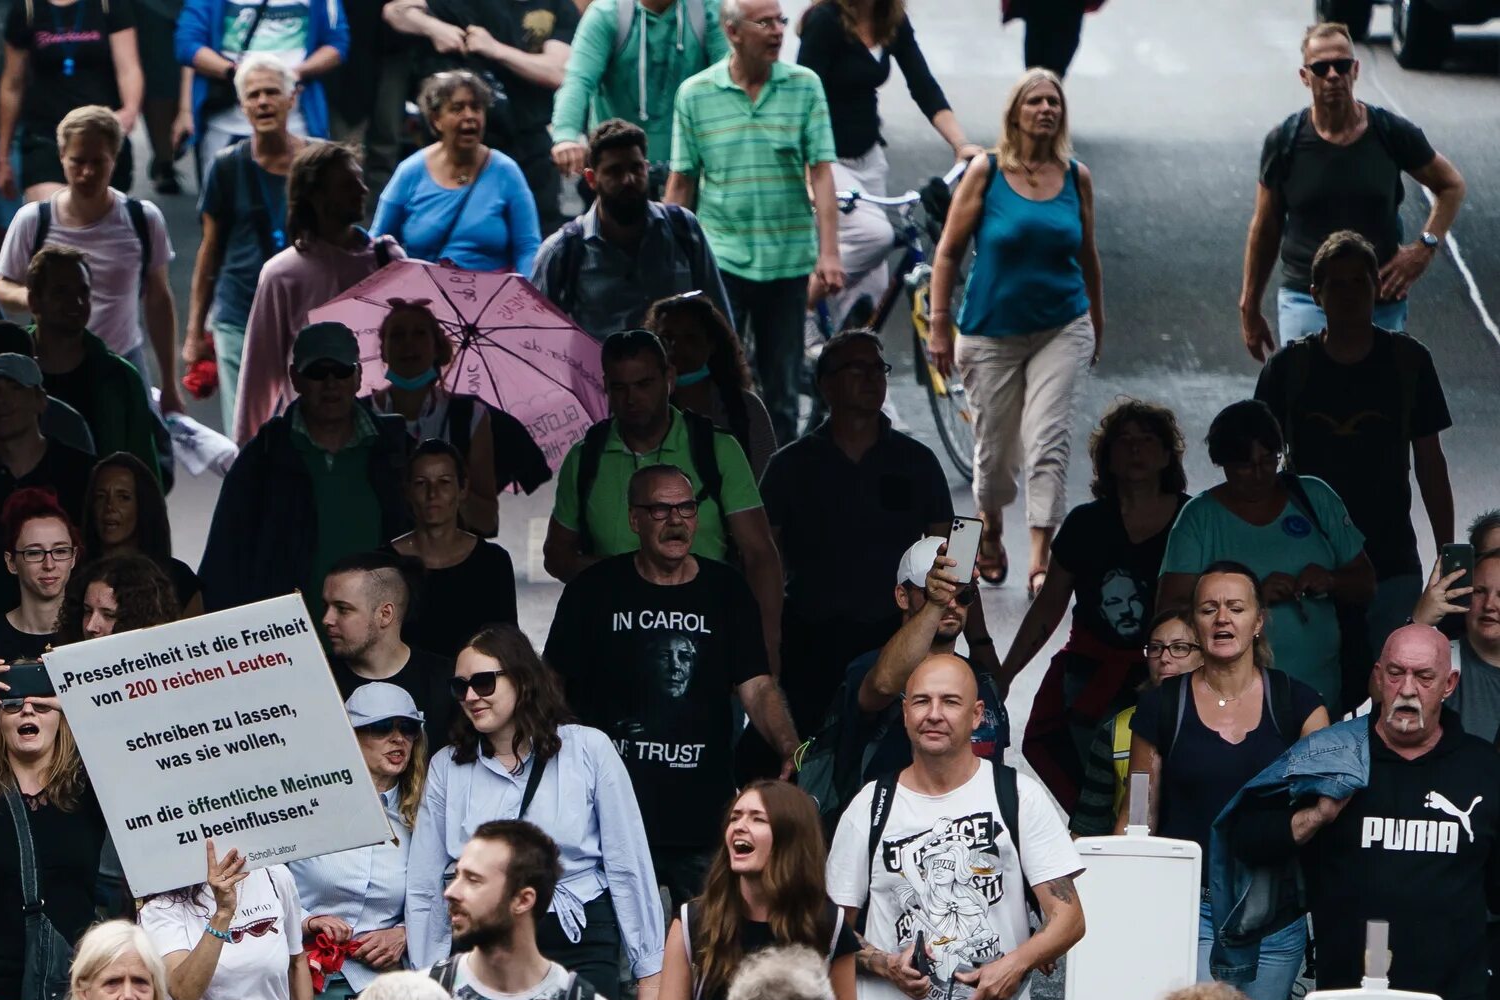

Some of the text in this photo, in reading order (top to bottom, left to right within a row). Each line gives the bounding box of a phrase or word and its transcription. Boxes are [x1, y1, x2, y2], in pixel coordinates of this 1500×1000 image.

[184, 640, 210, 660] ist
[211, 632, 239, 654] die
[240, 616, 309, 647] Freiheit
[613, 610, 712, 634] IN CAROL
[91, 649, 294, 708] von 200 reichen Leuten,
[125, 701, 298, 752] schreiben zu lassen,
[155, 729, 287, 771] was sie wollen,
[635, 741, 706, 763] TRUST
[124, 767, 354, 831] um die öffentliche Meinung
[176, 827, 199, 845] zu
[1361, 816, 1459, 854] PUMA
